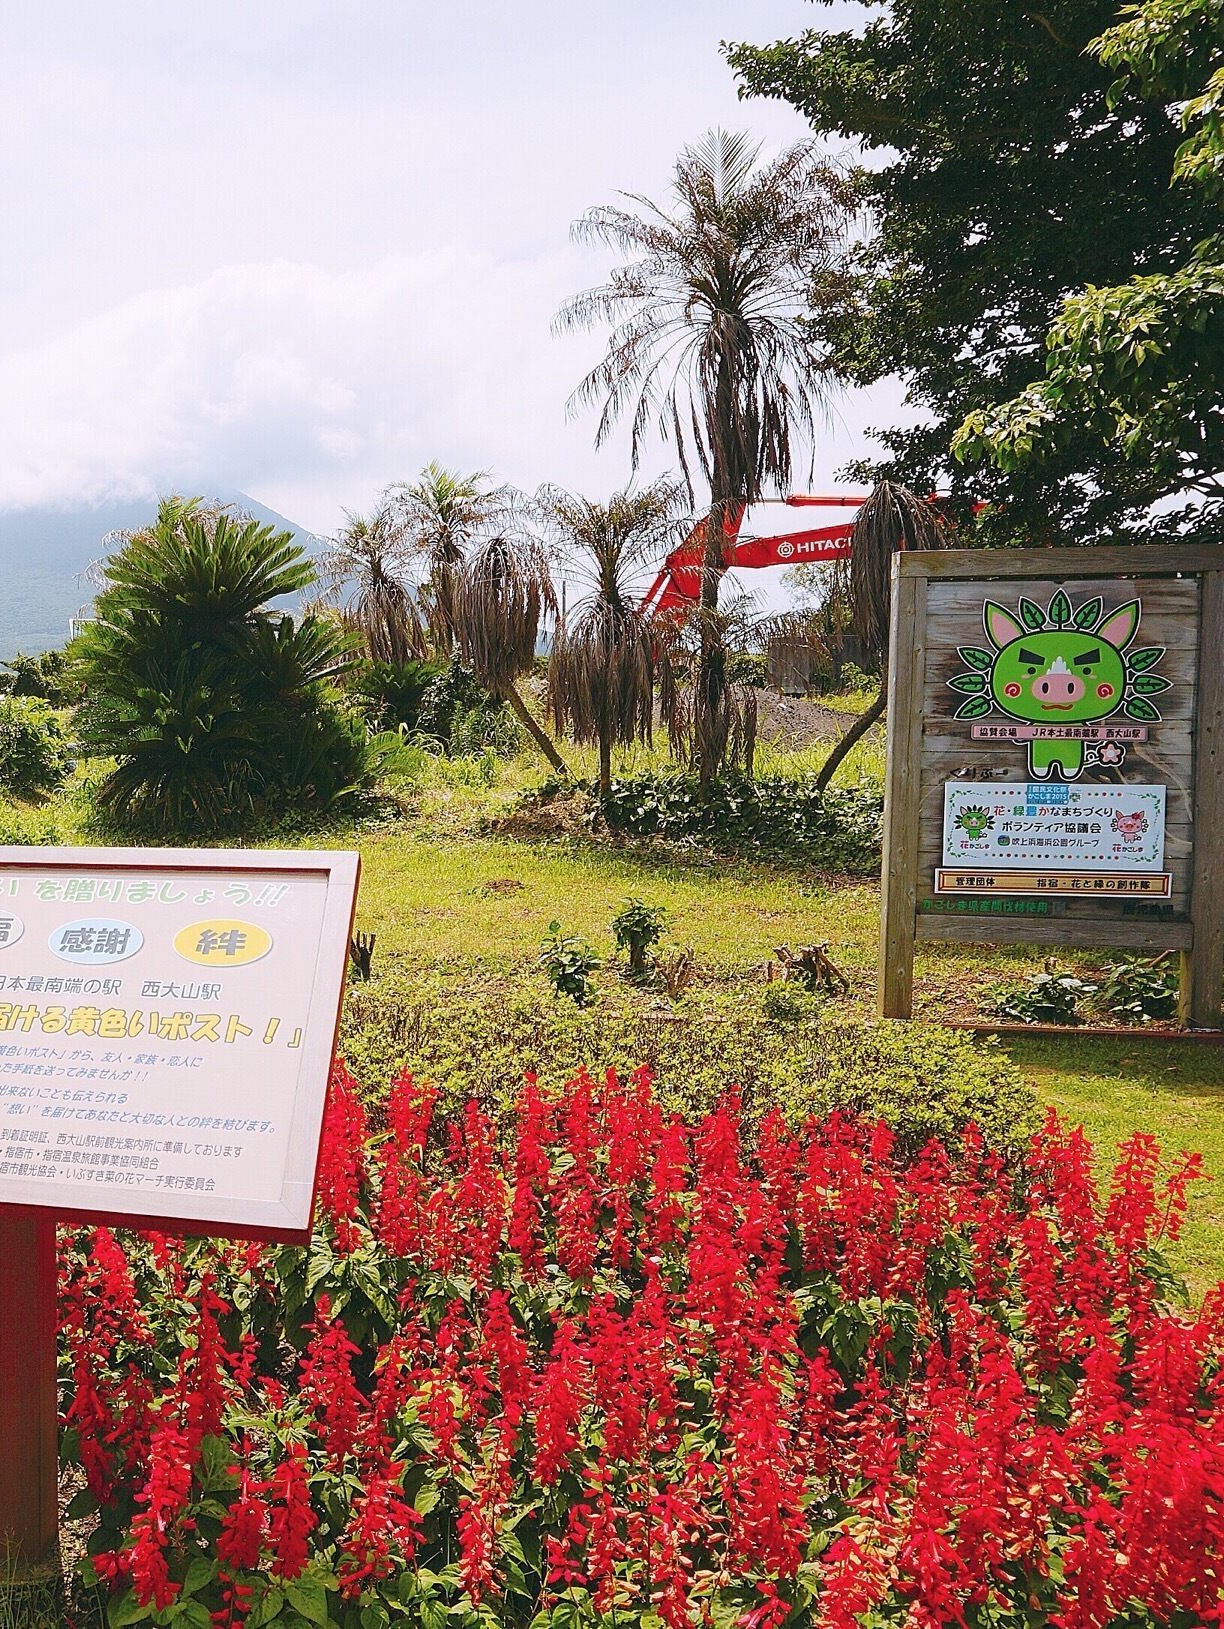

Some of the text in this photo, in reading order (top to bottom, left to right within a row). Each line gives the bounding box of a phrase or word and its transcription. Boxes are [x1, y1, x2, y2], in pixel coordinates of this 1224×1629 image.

[1105, 729, 1141, 738] 西大山駅
[1002, 821, 1102, 834] ボランティア協議会
[955, 876, 996, 887] 管理団体
[59, 927, 131, 955] 感謝
[195, 928, 248, 956] 絆
[141, 980, 222, 1001] 西大山駅
